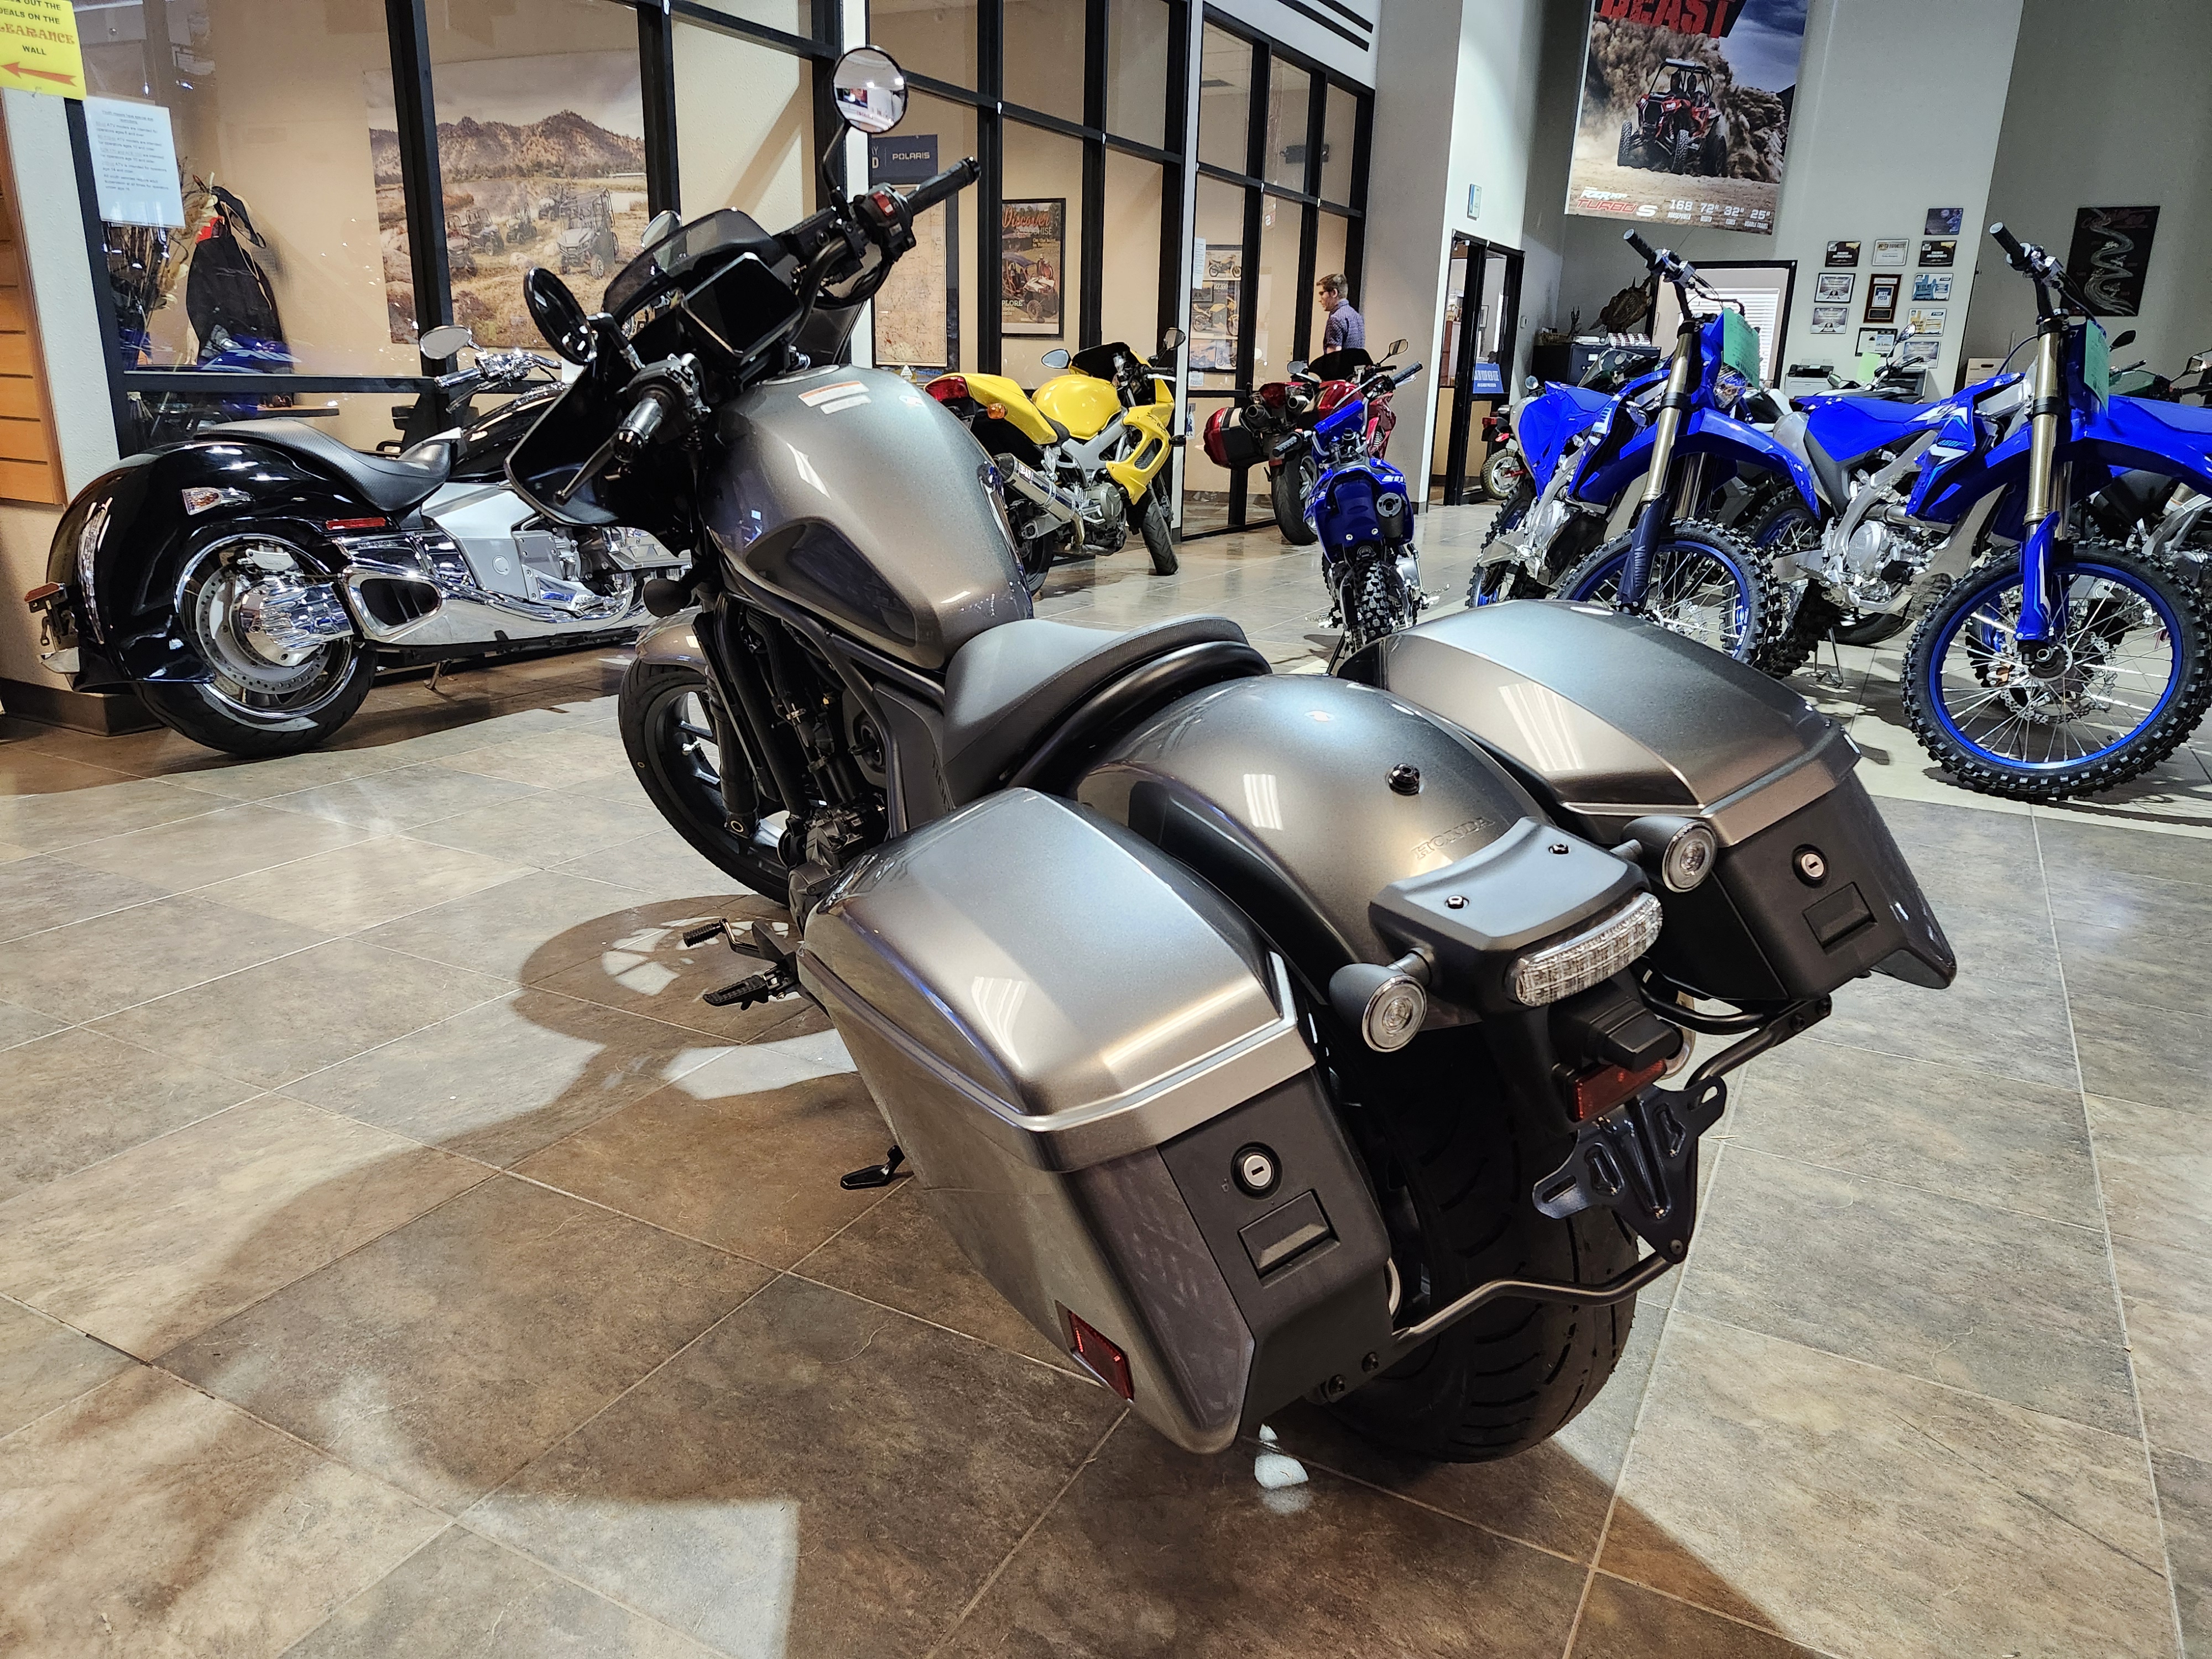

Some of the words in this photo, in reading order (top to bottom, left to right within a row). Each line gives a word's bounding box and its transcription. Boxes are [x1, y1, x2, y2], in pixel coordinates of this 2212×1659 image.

[44, 2, 61, 11] THE
[43, 15, 60, 24] THE
[22, 45, 47, 55] WALL
[892, 152, 931, 161] POLARIS
[1577, 198, 1639, 213] TURBO
[1636, 205, 1658, 217] S
[1670, 199, 1693, 212] 168
[1700, 202, 1720, 215] 72"
[1724, 206, 1745, 217] 32"
[1002, 205, 1051, 228] Discover
[1750, 209, 1771, 220] 25"
[1634, 545, 1646, 588] YAMAHA
[1411, 816, 1496, 860] HONDA
